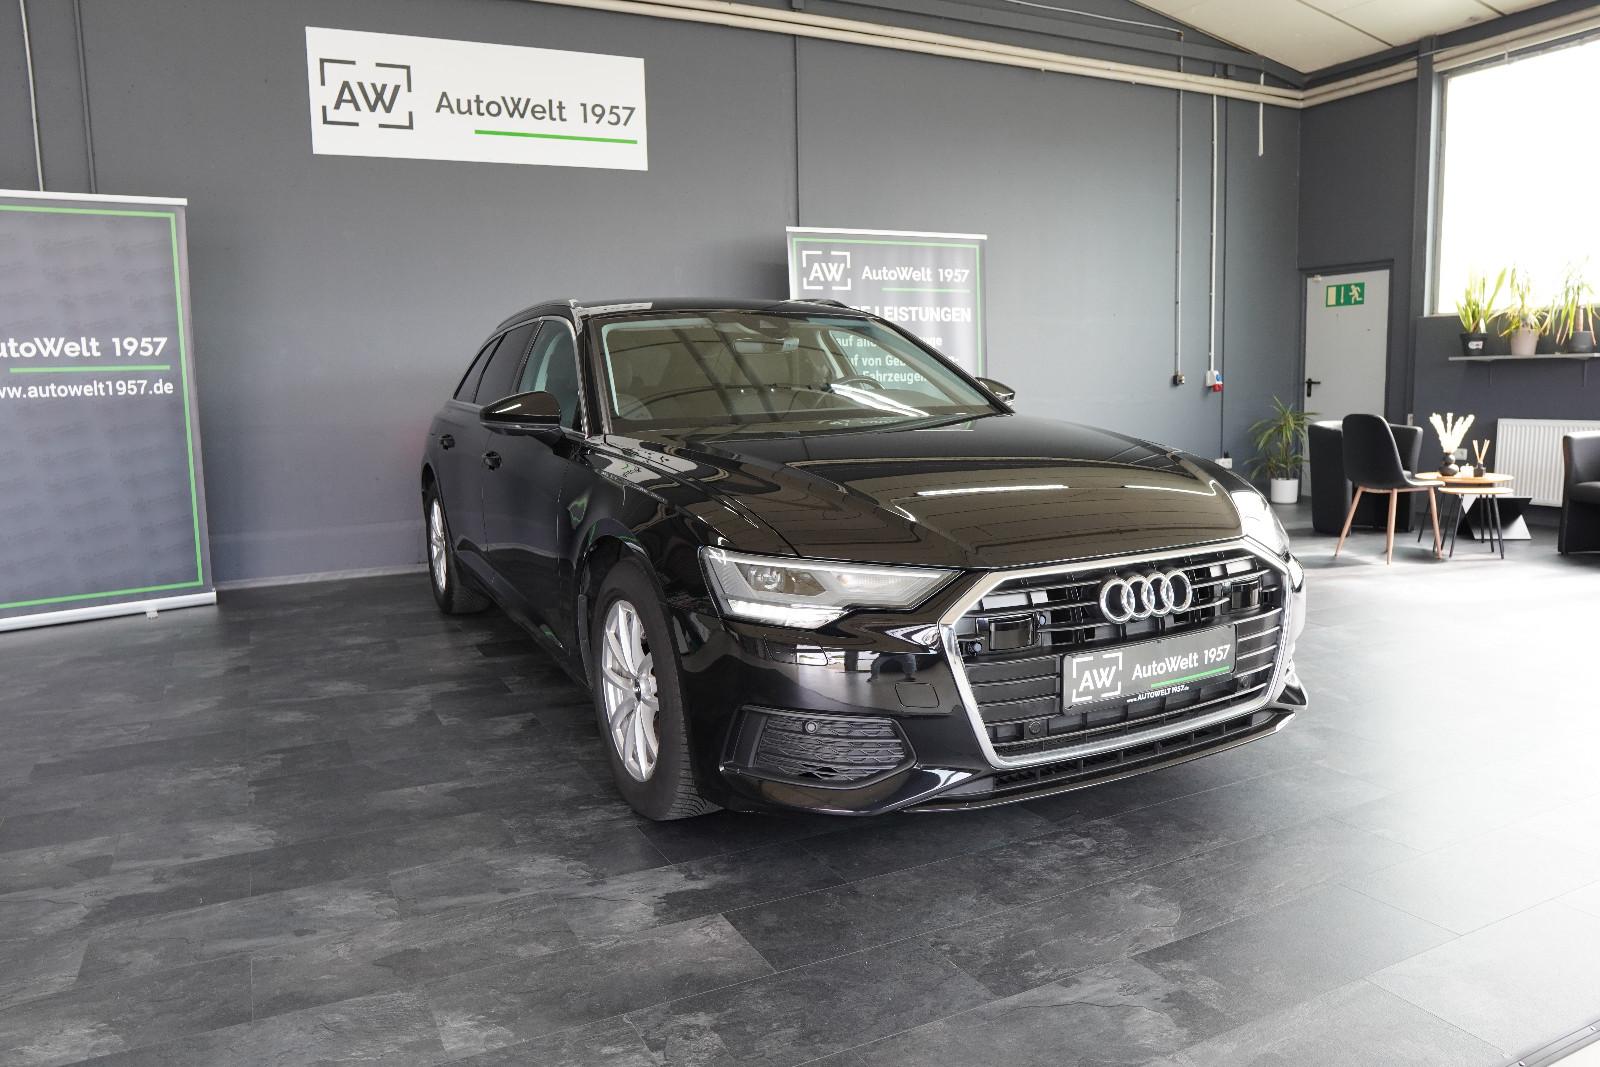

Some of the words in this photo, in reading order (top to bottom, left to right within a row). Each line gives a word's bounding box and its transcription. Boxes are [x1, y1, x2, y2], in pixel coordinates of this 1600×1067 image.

[334, 81, 401, 113] AW
[435, 91, 567, 122] AutoWelt
[579, 103, 636, 126] 1957
[809, 262, 845, 281] AW
[861, 266, 933, 282] AutoWelt
[938, 268, 970, 283] 1957
[111, 337, 168, 357] 1957
[861, 357, 882, 367] von
[1131, 653, 1199, 681] AutoWelt
[1203, 644, 1231, 665] 1957
[1078, 666, 1117, 692] AW
